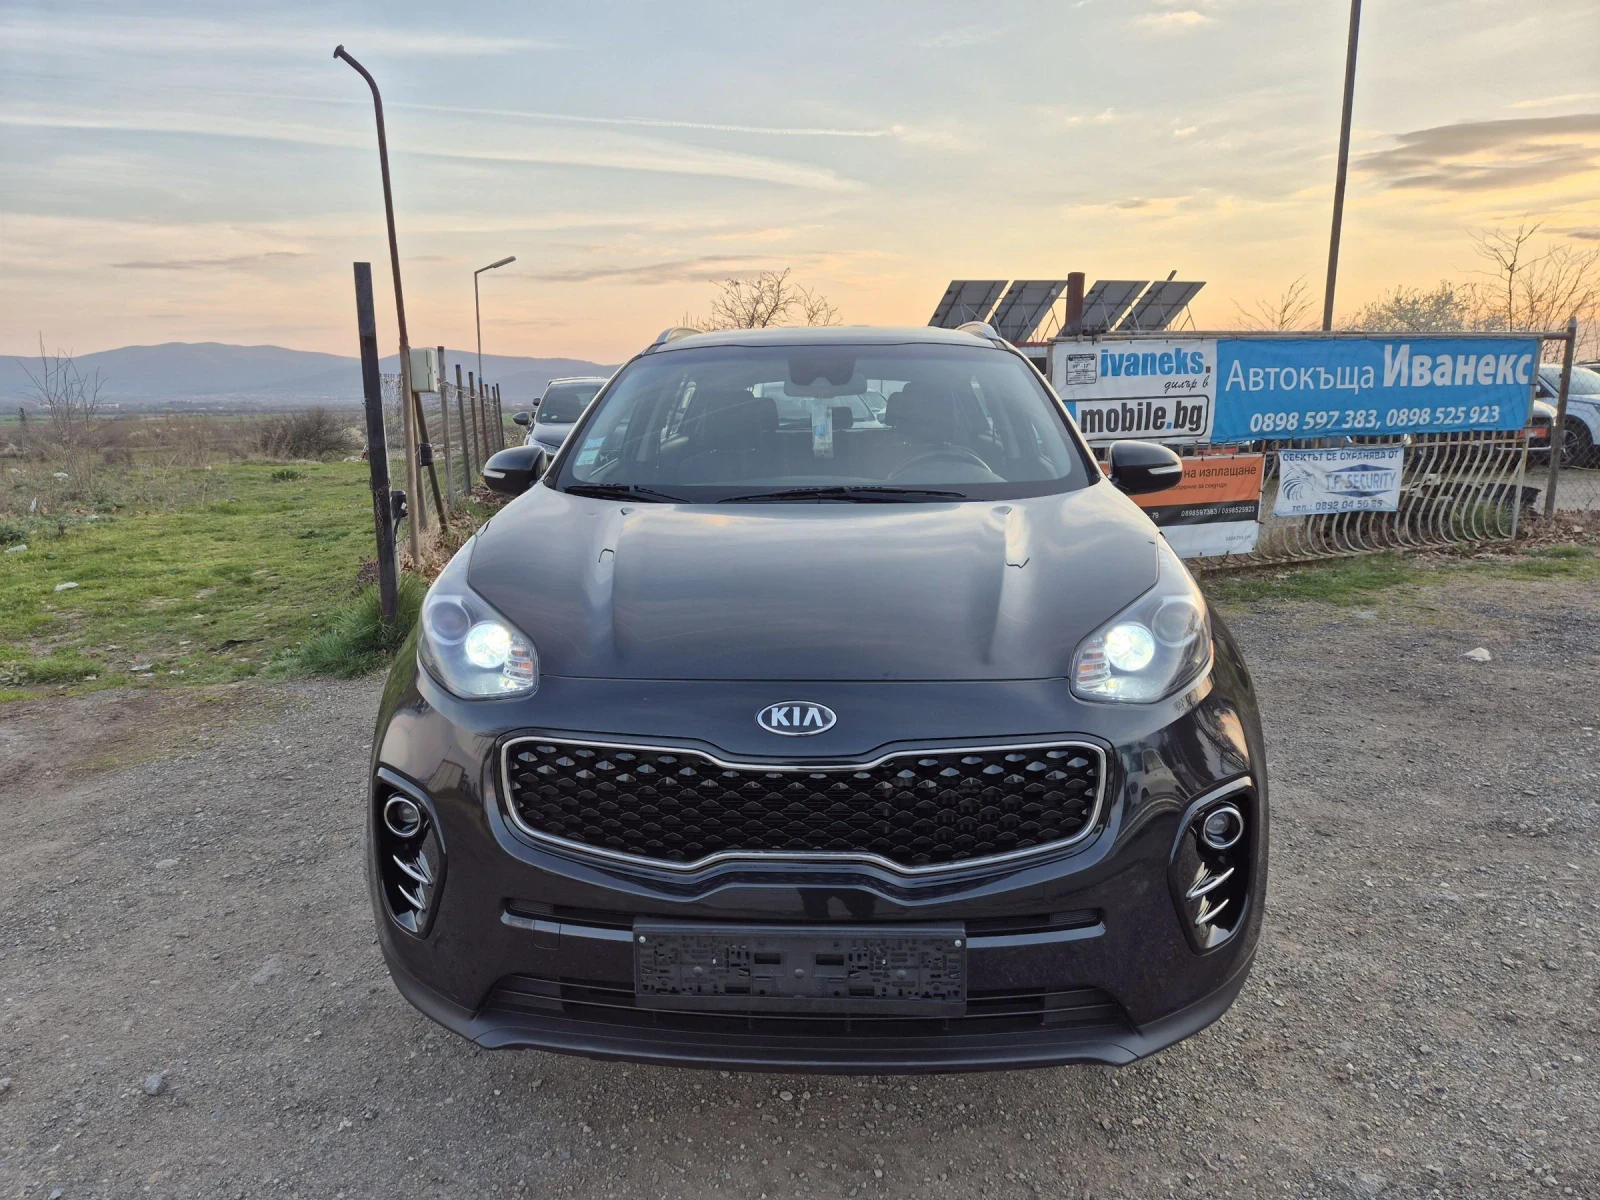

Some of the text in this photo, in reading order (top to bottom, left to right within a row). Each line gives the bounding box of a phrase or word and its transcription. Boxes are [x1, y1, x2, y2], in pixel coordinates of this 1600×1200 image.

[1101, 348, 1211, 377] ivaneks.
[1225, 344, 1533, 395] Автокъща Иванекс
[1164, 379, 1198, 394] дилър
[1080, 400, 1204, 434] mobile.bg
[1250, 405, 1500, 433] 0898 597 383, 0898 525 923
[1282, 450, 1399, 462] ОБЕКТЪТ СЕ ОХРАНЯВА ОТ
[1183, 466, 1257, 479] на изплащане
[1345, 472, 1397, 490] SECURITY
[1315, 501, 1339, 511] 0892
[1341, 500, 1354, 509] 04
[770, 706, 824, 727] KIA
